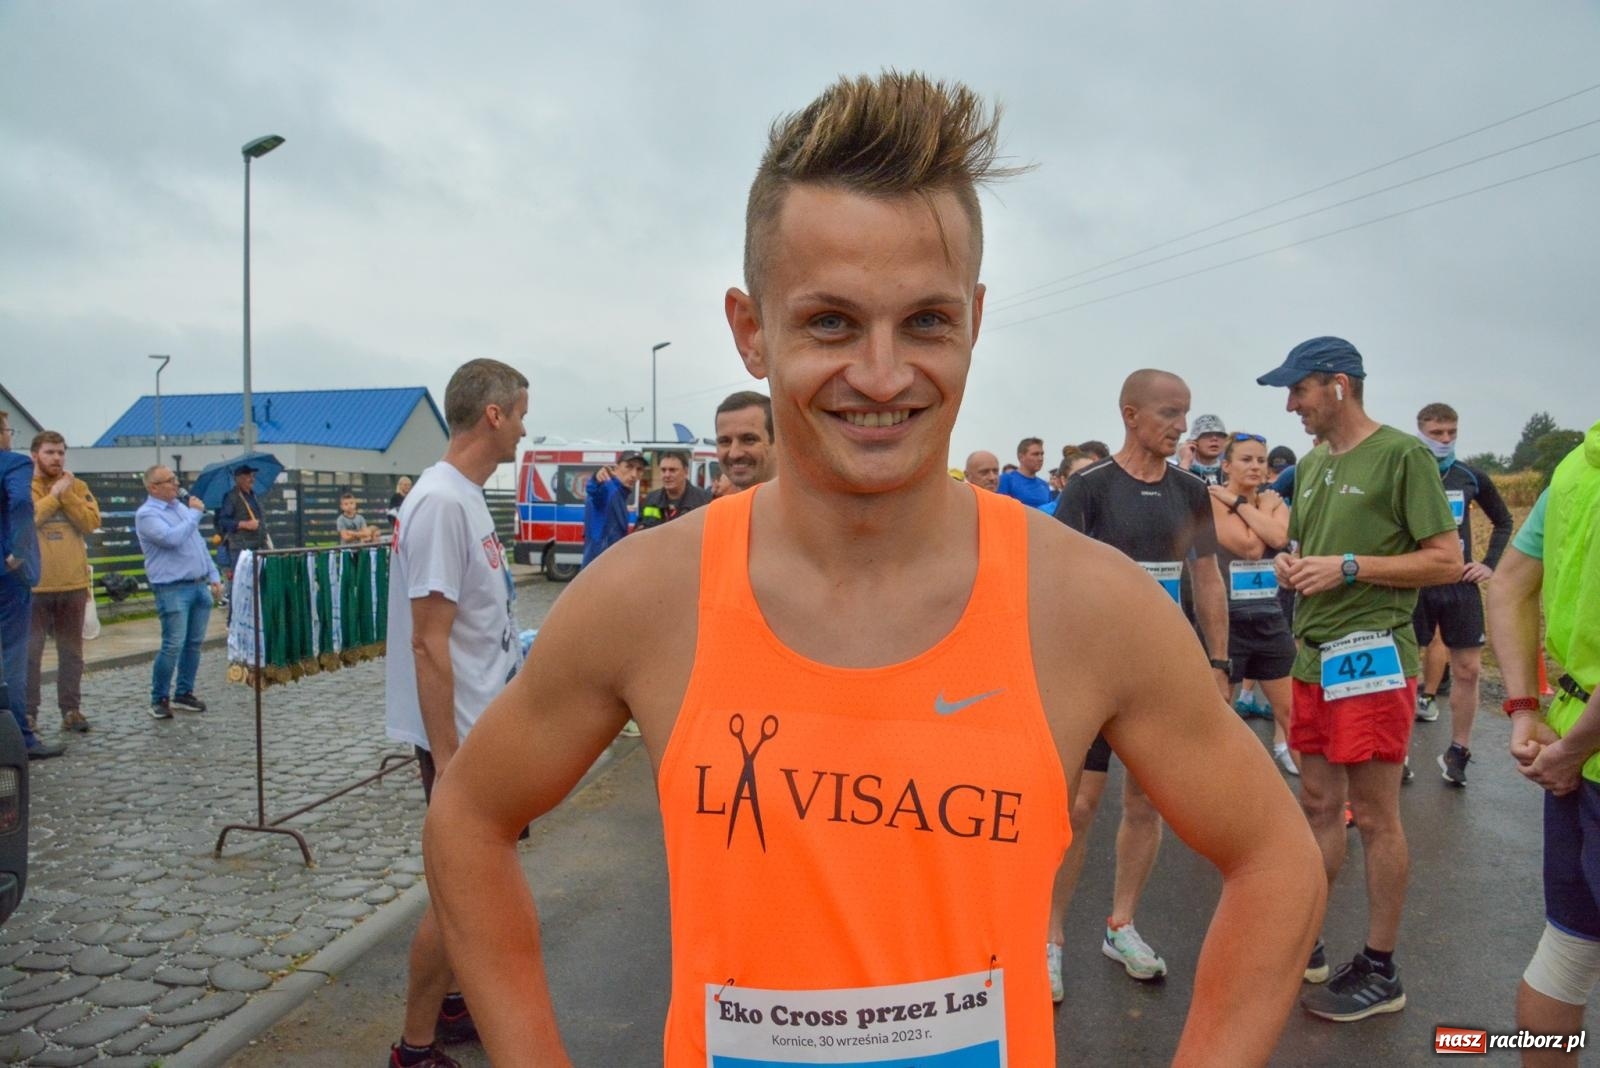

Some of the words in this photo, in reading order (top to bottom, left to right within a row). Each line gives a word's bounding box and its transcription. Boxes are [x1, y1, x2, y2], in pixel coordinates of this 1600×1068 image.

[1252, 572, 1263, 589] 4
[1338, 652, 1377, 680] 42
[779, 767, 1023, 844] VISAGE
[719, 1000, 763, 1025] Eko
[770, 1004, 848, 1027] Cross
[856, 999, 937, 1029] przez
[944, 989, 988, 1014] Las
[771, 1034, 817, 1049] Kornice,
[818, 1035, 834, 1048] 30
[835, 1032, 889, 1046] września
[891, 1029, 922, 1043] 2023
[924, 1028, 933, 1040] r.
